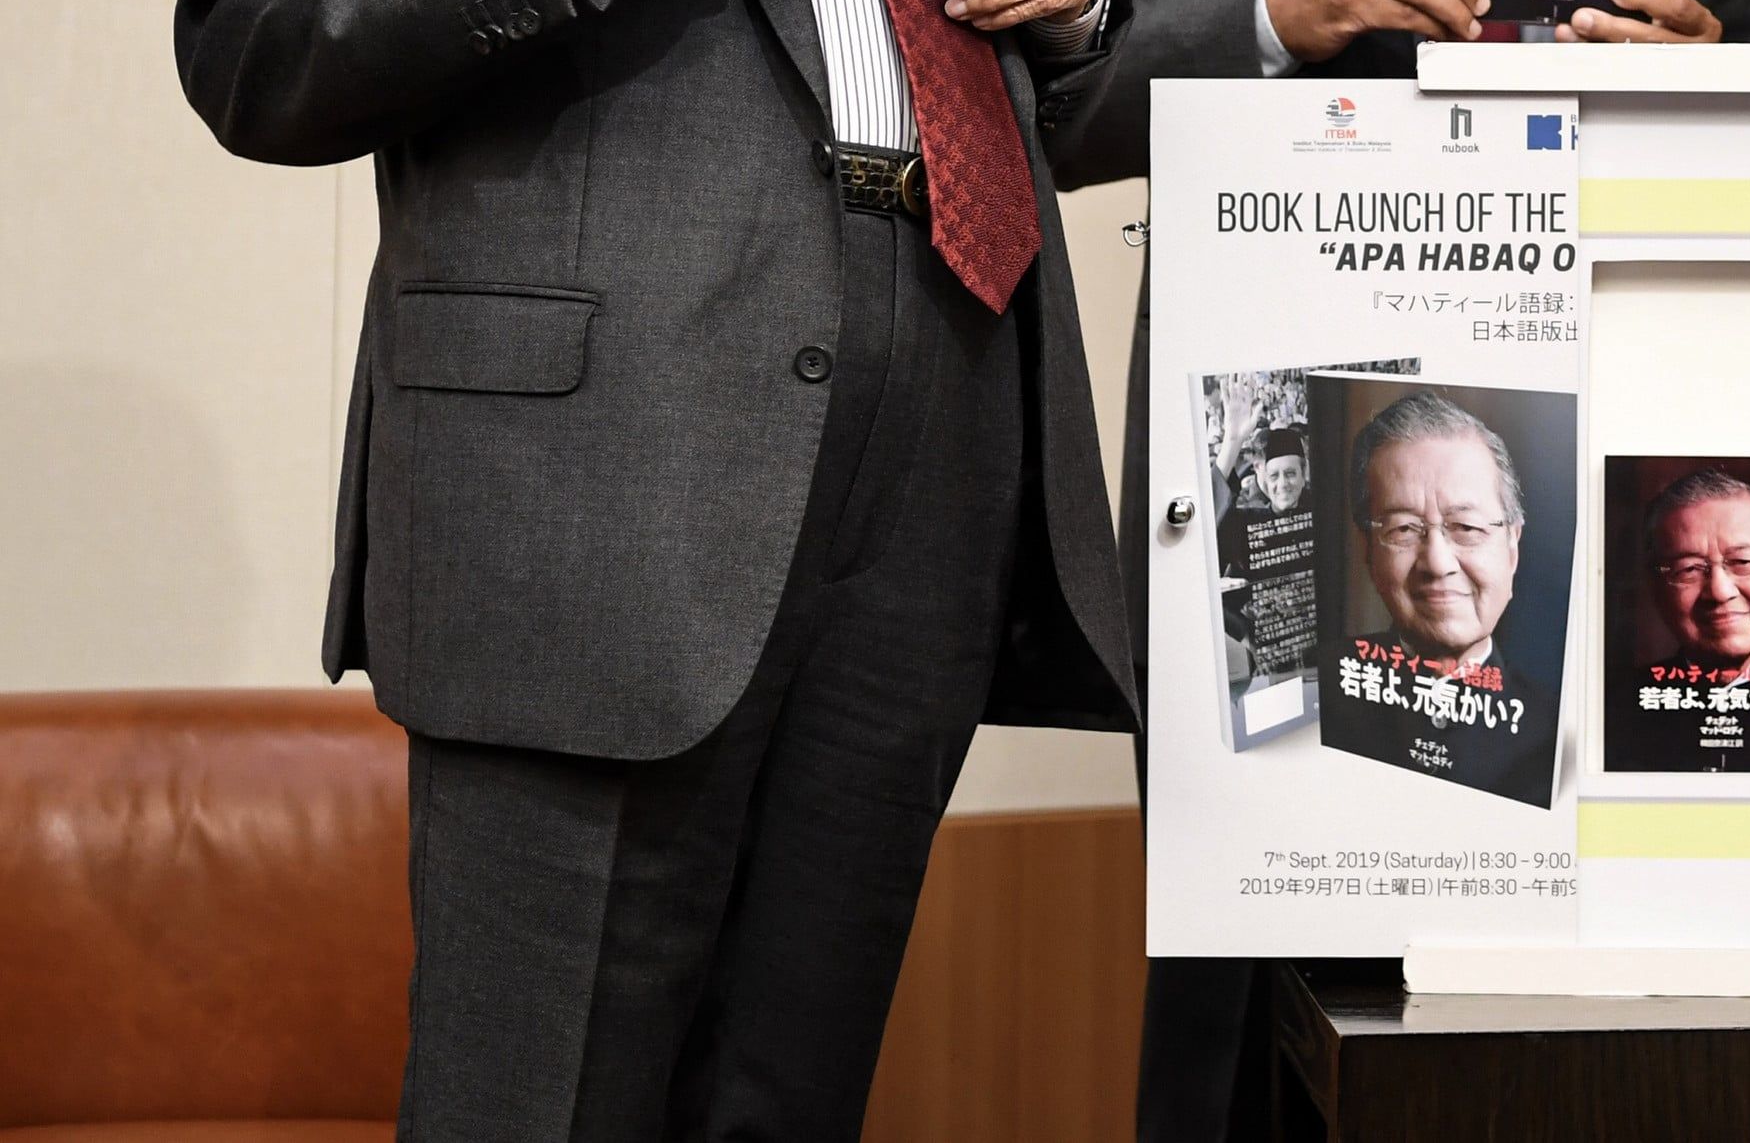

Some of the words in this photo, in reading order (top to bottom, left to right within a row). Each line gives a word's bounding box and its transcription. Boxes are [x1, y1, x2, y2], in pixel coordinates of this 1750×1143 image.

[1441, 143, 1480, 153] nubook
[1218, 193, 1303, 232] BOOK
[1316, 193, 1443, 232] LAUNCH
[1457, 193, 1494, 232] OF
[1505, 193, 1566, 232] THE
[1418, 243, 1540, 274] HABAQ
[1356, 639, 1504, 692] マハティール語録
[1339, 656, 1525, 735] 若者よ、元気かい？
[1288, 851, 1332, 871] Sept.
[1335, 851, 1380, 869] 2019
[1383, 850, 1469, 872] (Saturday)
[1479, 851, 1518, 869] 8:30
[1533, 852, 1571, 870] 9:00
